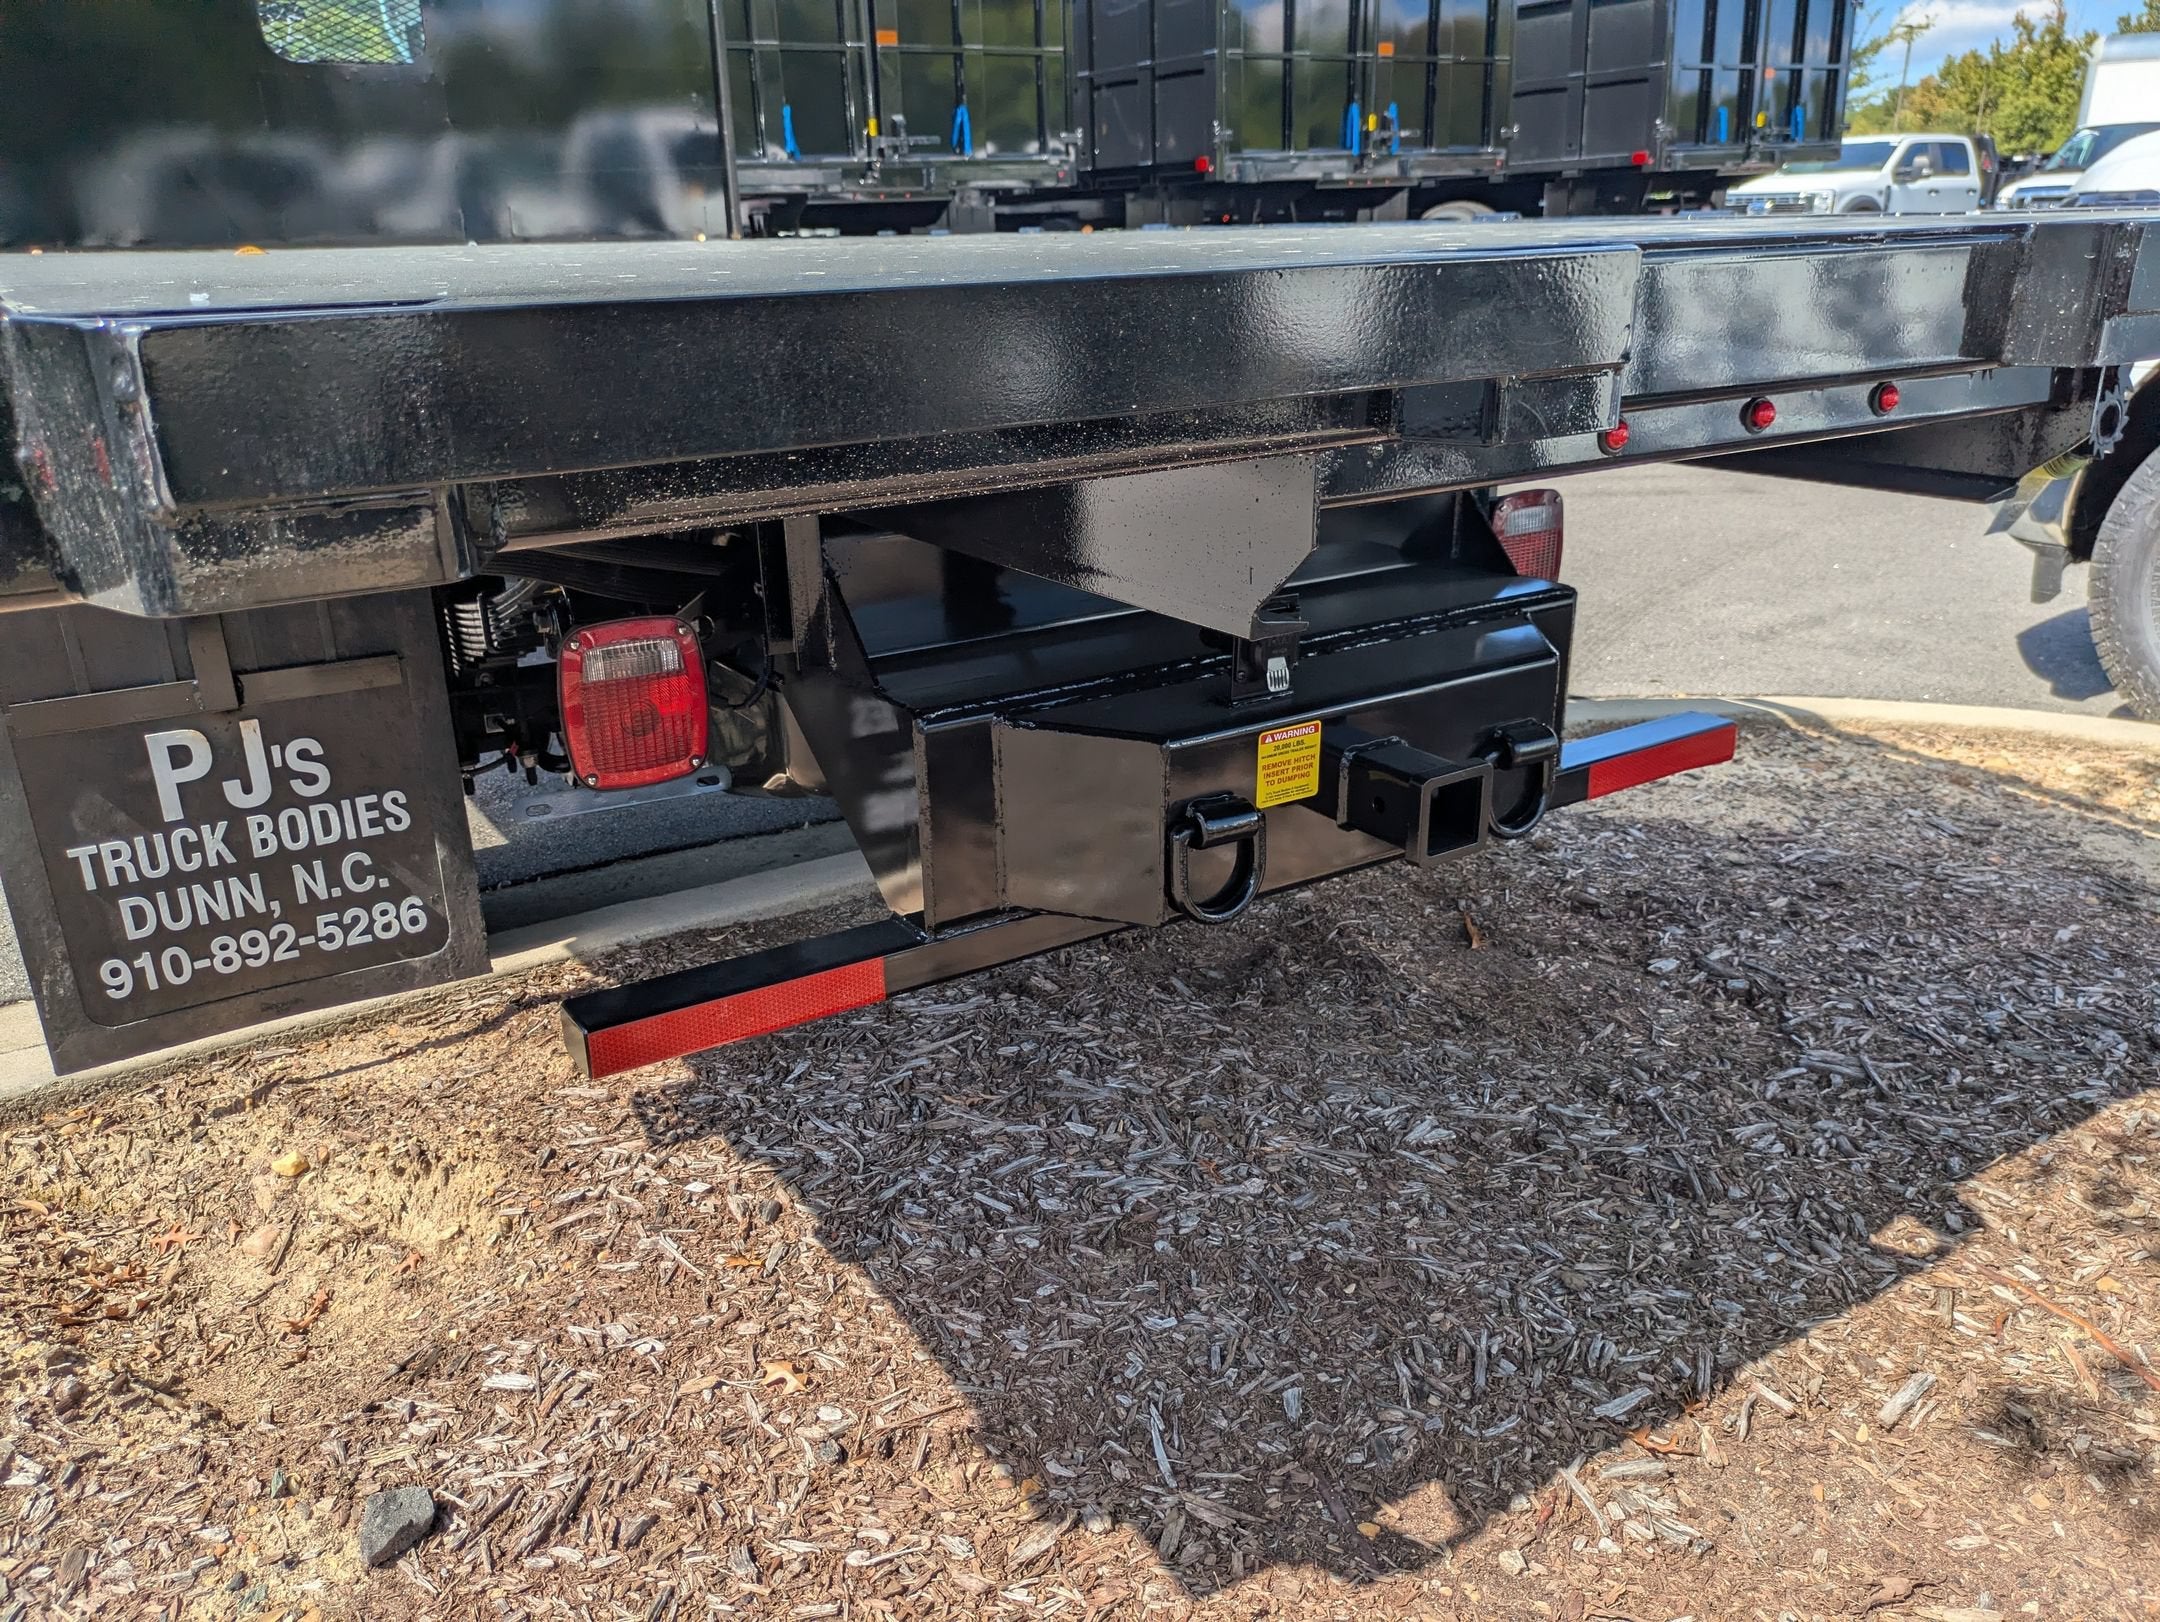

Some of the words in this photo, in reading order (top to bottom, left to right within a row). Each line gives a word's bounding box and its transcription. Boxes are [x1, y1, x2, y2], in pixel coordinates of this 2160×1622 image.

[1274, 726, 1315, 741] WARNING
[1262, 759, 1292, 771] REMOVE
[1294, 754, 1316, 764] HITCH
[1264, 767, 1290, 779] INSERT
[1292, 762, 1314, 773] PRIOR
[1265, 779, 1276, 787] TO
[1277, 771, 1311, 785] DUMPING
[65, 820, 237, 891] TRUCK
[245, 790, 411, 859] BODIES
[117, 872, 283, 940] DUNN,
[291, 851, 391, 905] N.C.
[99, 895, 428, 1000] 910-892-5286
